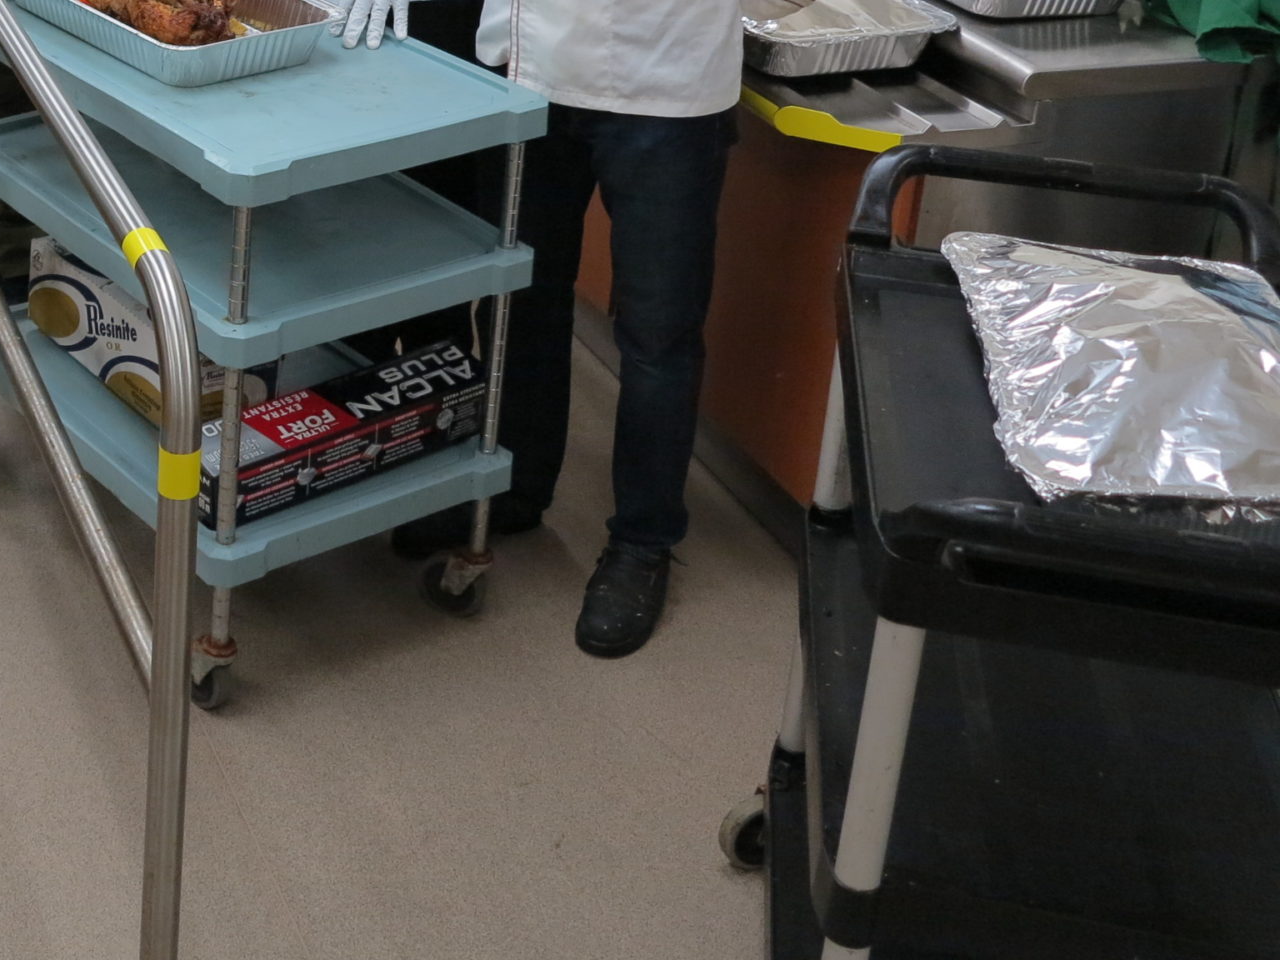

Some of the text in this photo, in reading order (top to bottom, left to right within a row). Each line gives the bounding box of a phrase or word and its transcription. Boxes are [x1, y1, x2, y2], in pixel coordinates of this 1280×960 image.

[85, 303, 138, 343] Resinite
[378, 345, 464, 383] PLUS
[345, 359, 472, 419] ALCAN
[261, 403, 303, 421] EXTRA
[276, 408, 336, 439] FORT
[294, 424, 331, 440] ULTRA
